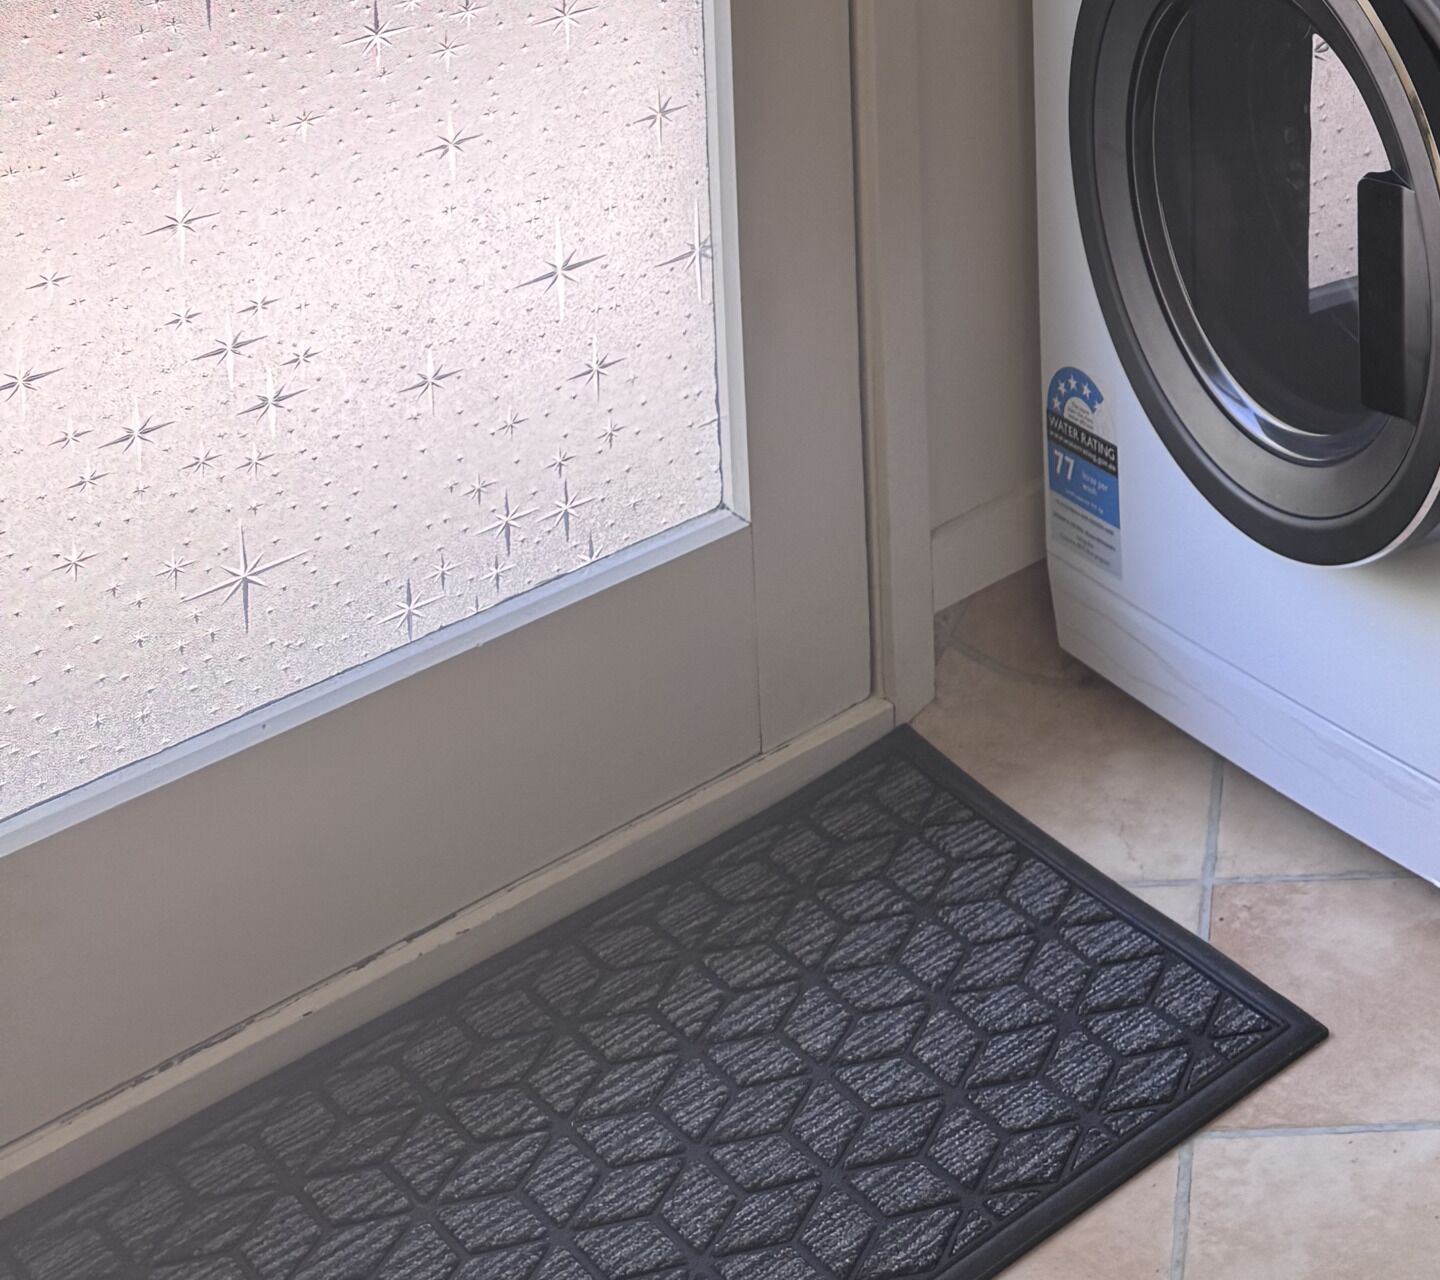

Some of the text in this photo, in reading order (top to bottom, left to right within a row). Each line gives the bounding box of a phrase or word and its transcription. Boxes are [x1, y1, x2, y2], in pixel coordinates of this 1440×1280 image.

[1049, 415, 1079, 441] WATER
[1081, 431, 1116, 461] RATING
[1054, 449, 1075, 481] 77
